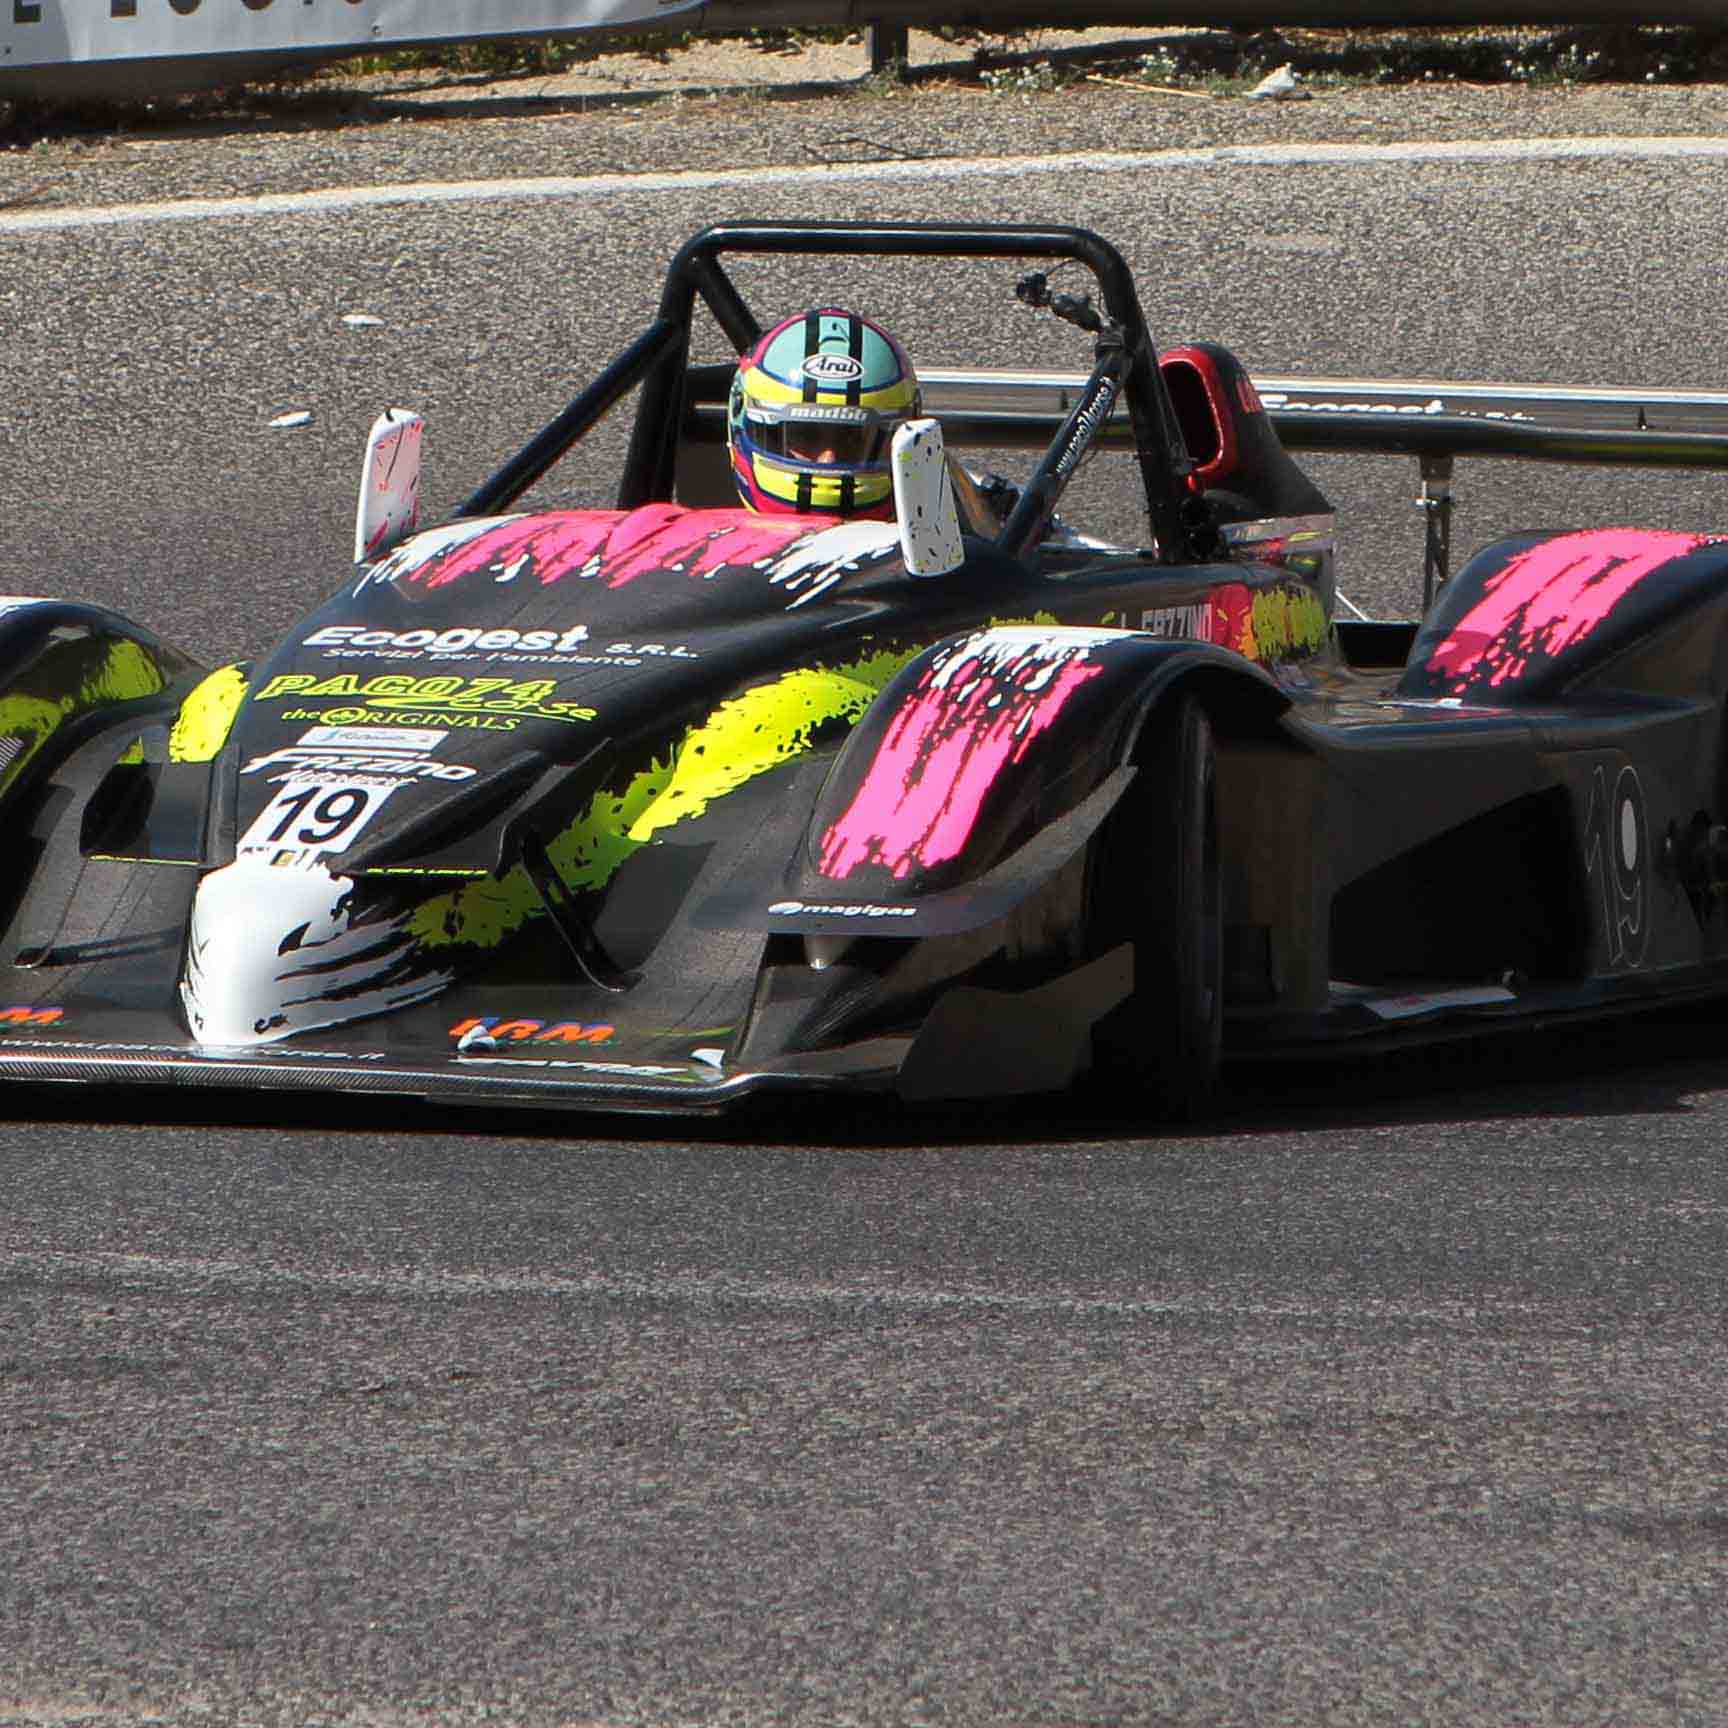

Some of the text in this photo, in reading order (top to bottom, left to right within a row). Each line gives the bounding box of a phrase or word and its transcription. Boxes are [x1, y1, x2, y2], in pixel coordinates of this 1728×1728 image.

[810, 355, 855, 374] Arai
[301, 624, 589, 654] Ecogest
[254, 673, 558, 702] PACO74
[266, 785, 370, 845] 19
